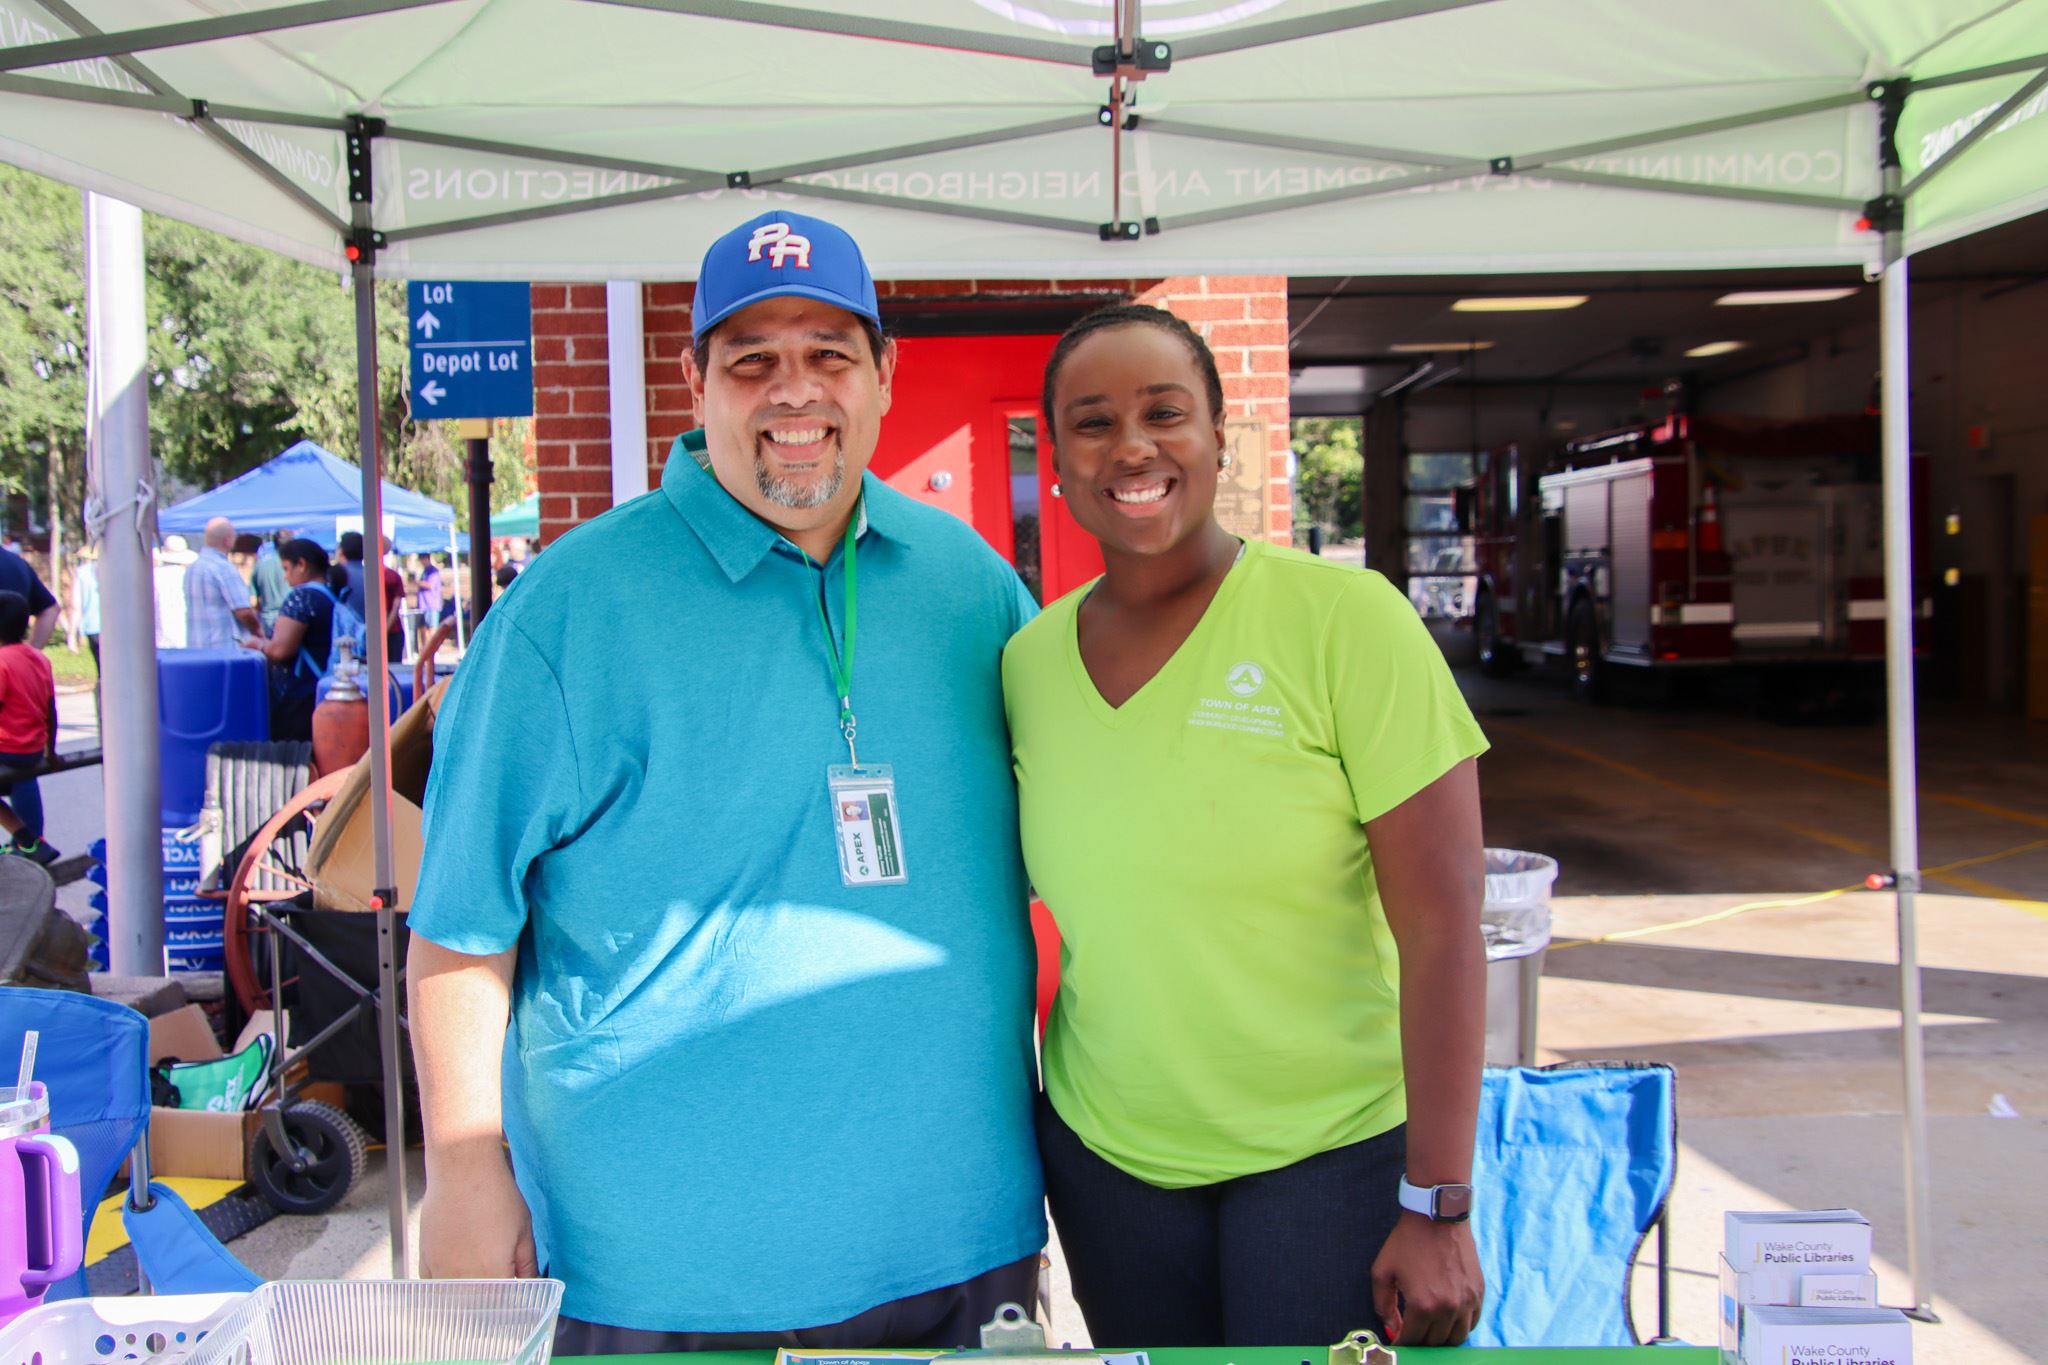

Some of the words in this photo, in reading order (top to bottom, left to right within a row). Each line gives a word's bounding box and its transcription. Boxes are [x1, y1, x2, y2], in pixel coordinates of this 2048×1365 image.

[423, 282, 453, 304] Lot
[423, 351, 480, 377] Depot
[488, 350, 519, 371] Lot
[1200, 698, 1232, 709] TOWN
[1234, 703, 1248, 712] OF
[1252, 706, 1280, 717] APEX
[853, 832, 865, 863] APEX
[1764, 1242, 1794, 1251] Wake
[1795, 1241, 1832, 1253] County
[1764, 1253, 1801, 1264] Public
[1804, 1252, 1855, 1263] Libraries
[1791, 1344, 1825, 1356] Wake
[1827, 1344, 1870, 1359] County
